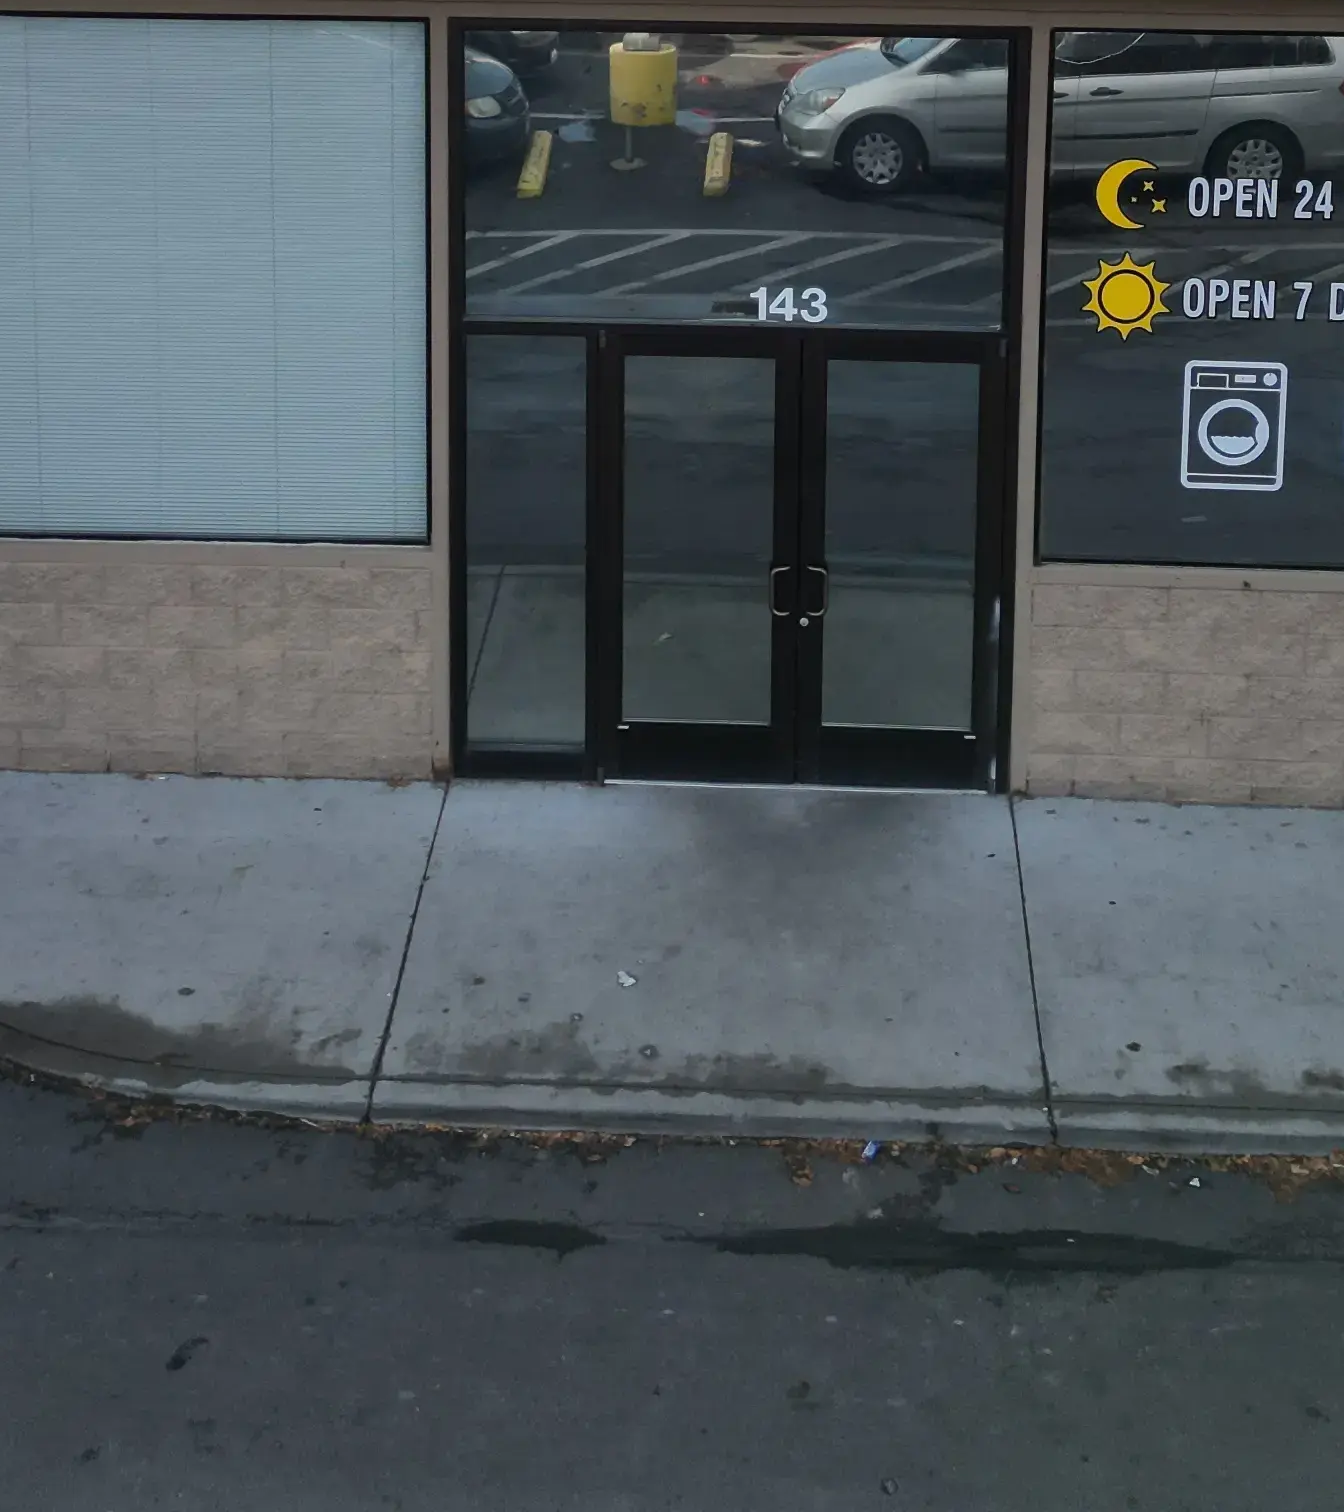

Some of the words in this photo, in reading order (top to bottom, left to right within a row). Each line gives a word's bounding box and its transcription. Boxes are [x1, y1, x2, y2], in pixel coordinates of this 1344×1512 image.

[1188, 176, 1279, 218] OPEN
[1294, 180, 1334, 219] 24
[749, 286, 828, 323] 143
[1183, 278, 1276, 320] OPEN
[1293, 282, 1313, 320] 7
